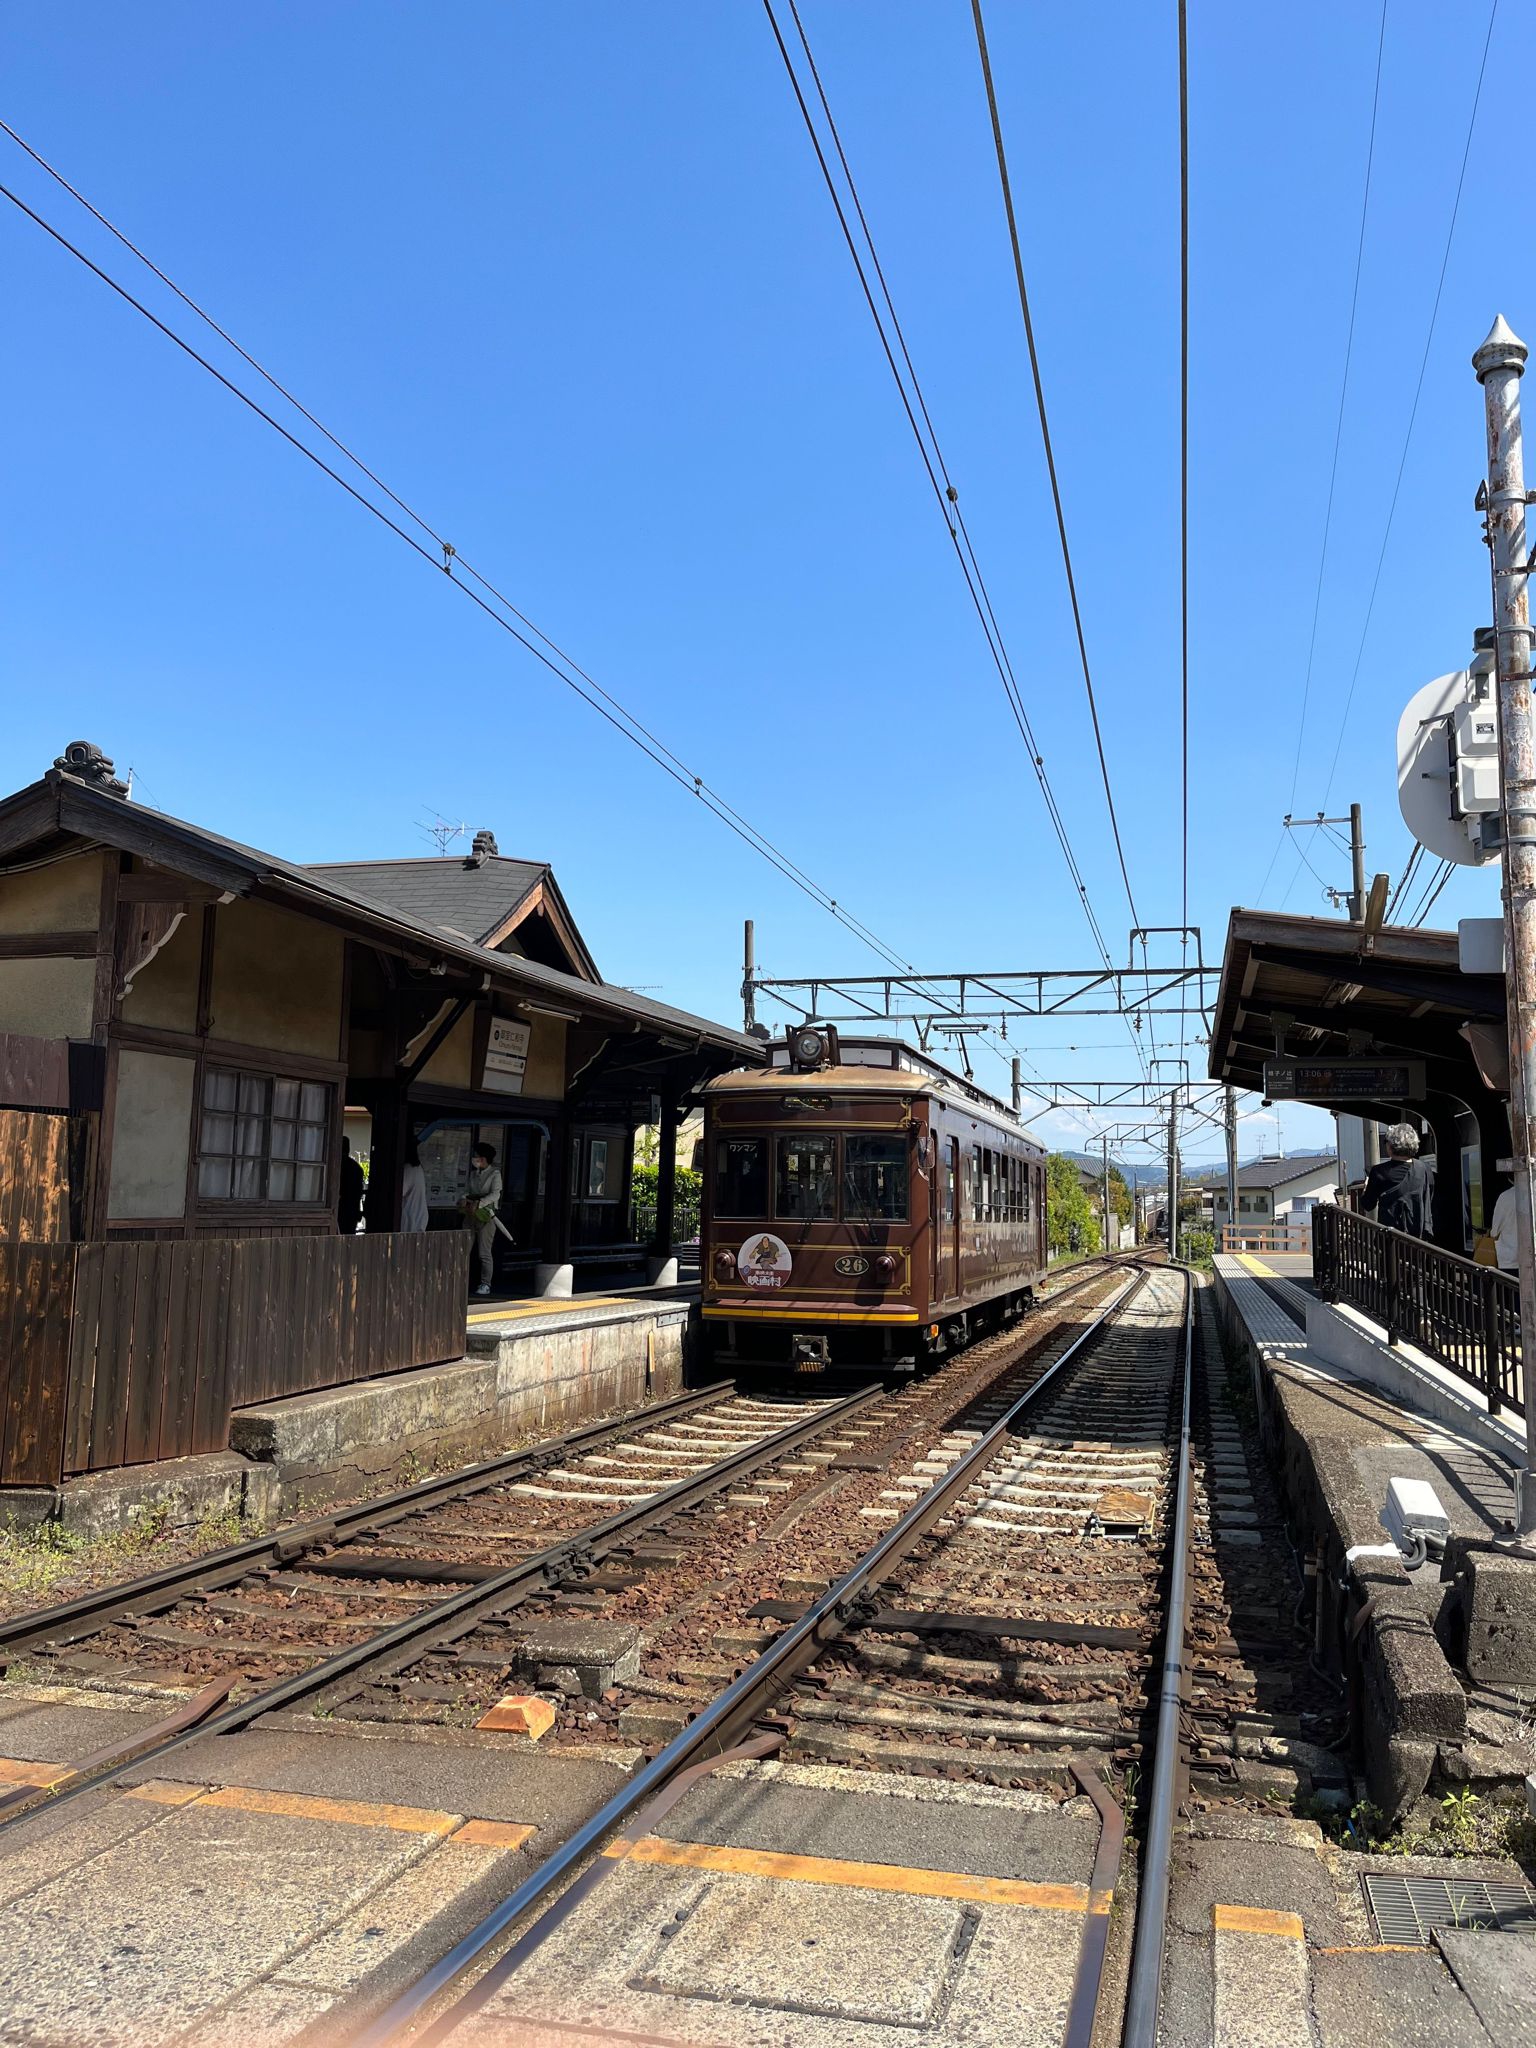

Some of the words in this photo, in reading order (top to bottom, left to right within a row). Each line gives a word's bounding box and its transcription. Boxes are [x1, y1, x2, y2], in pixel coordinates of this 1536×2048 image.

[729, 1144, 757, 1153] ワンマン
[841, 1258, 863, 1272] 26
[747, 1275, 782, 1287] 映画村
